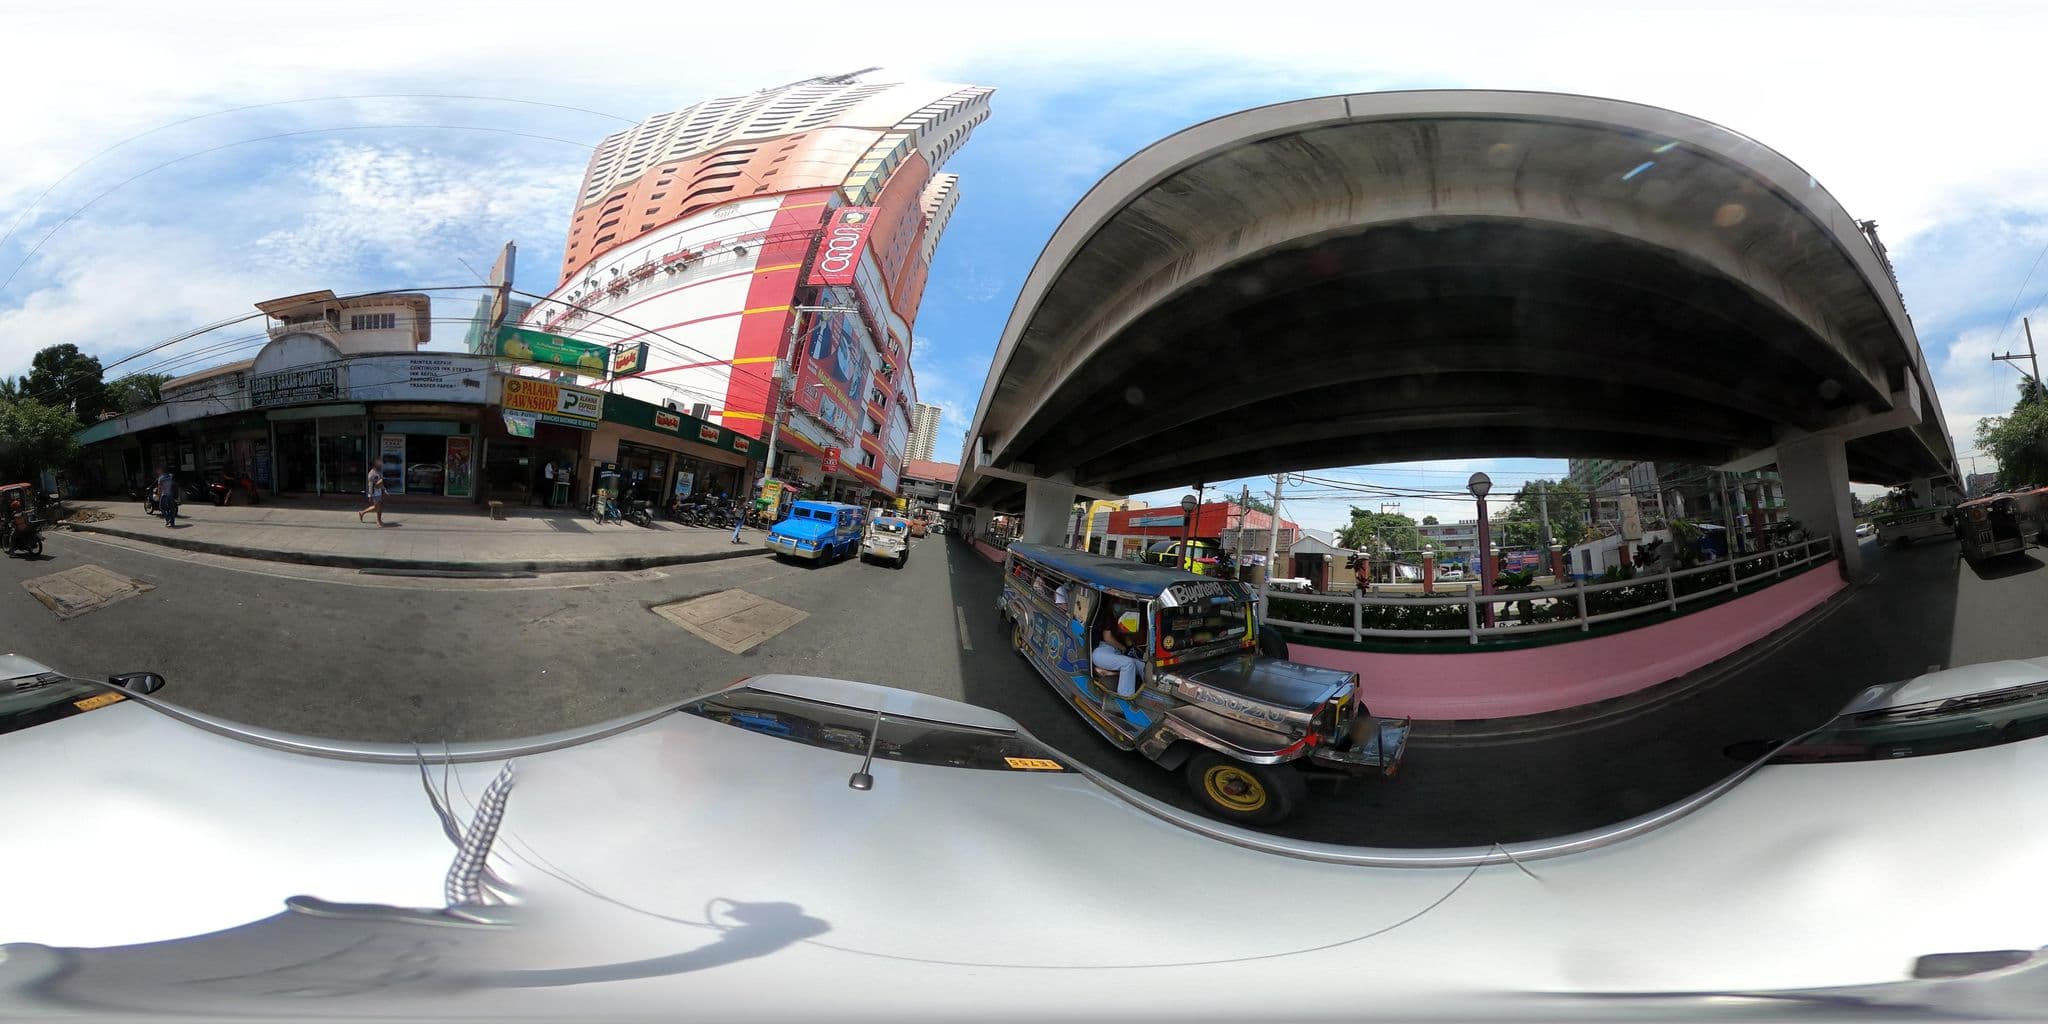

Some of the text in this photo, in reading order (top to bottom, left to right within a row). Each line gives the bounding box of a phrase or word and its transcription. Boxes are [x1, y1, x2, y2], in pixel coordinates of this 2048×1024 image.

[821, 226, 863, 273] SOGO
[298, 367, 334, 388] COMPUTER
[521, 381, 559, 398] PALAWAN
[506, 392, 559, 412] PAWNSHOP
